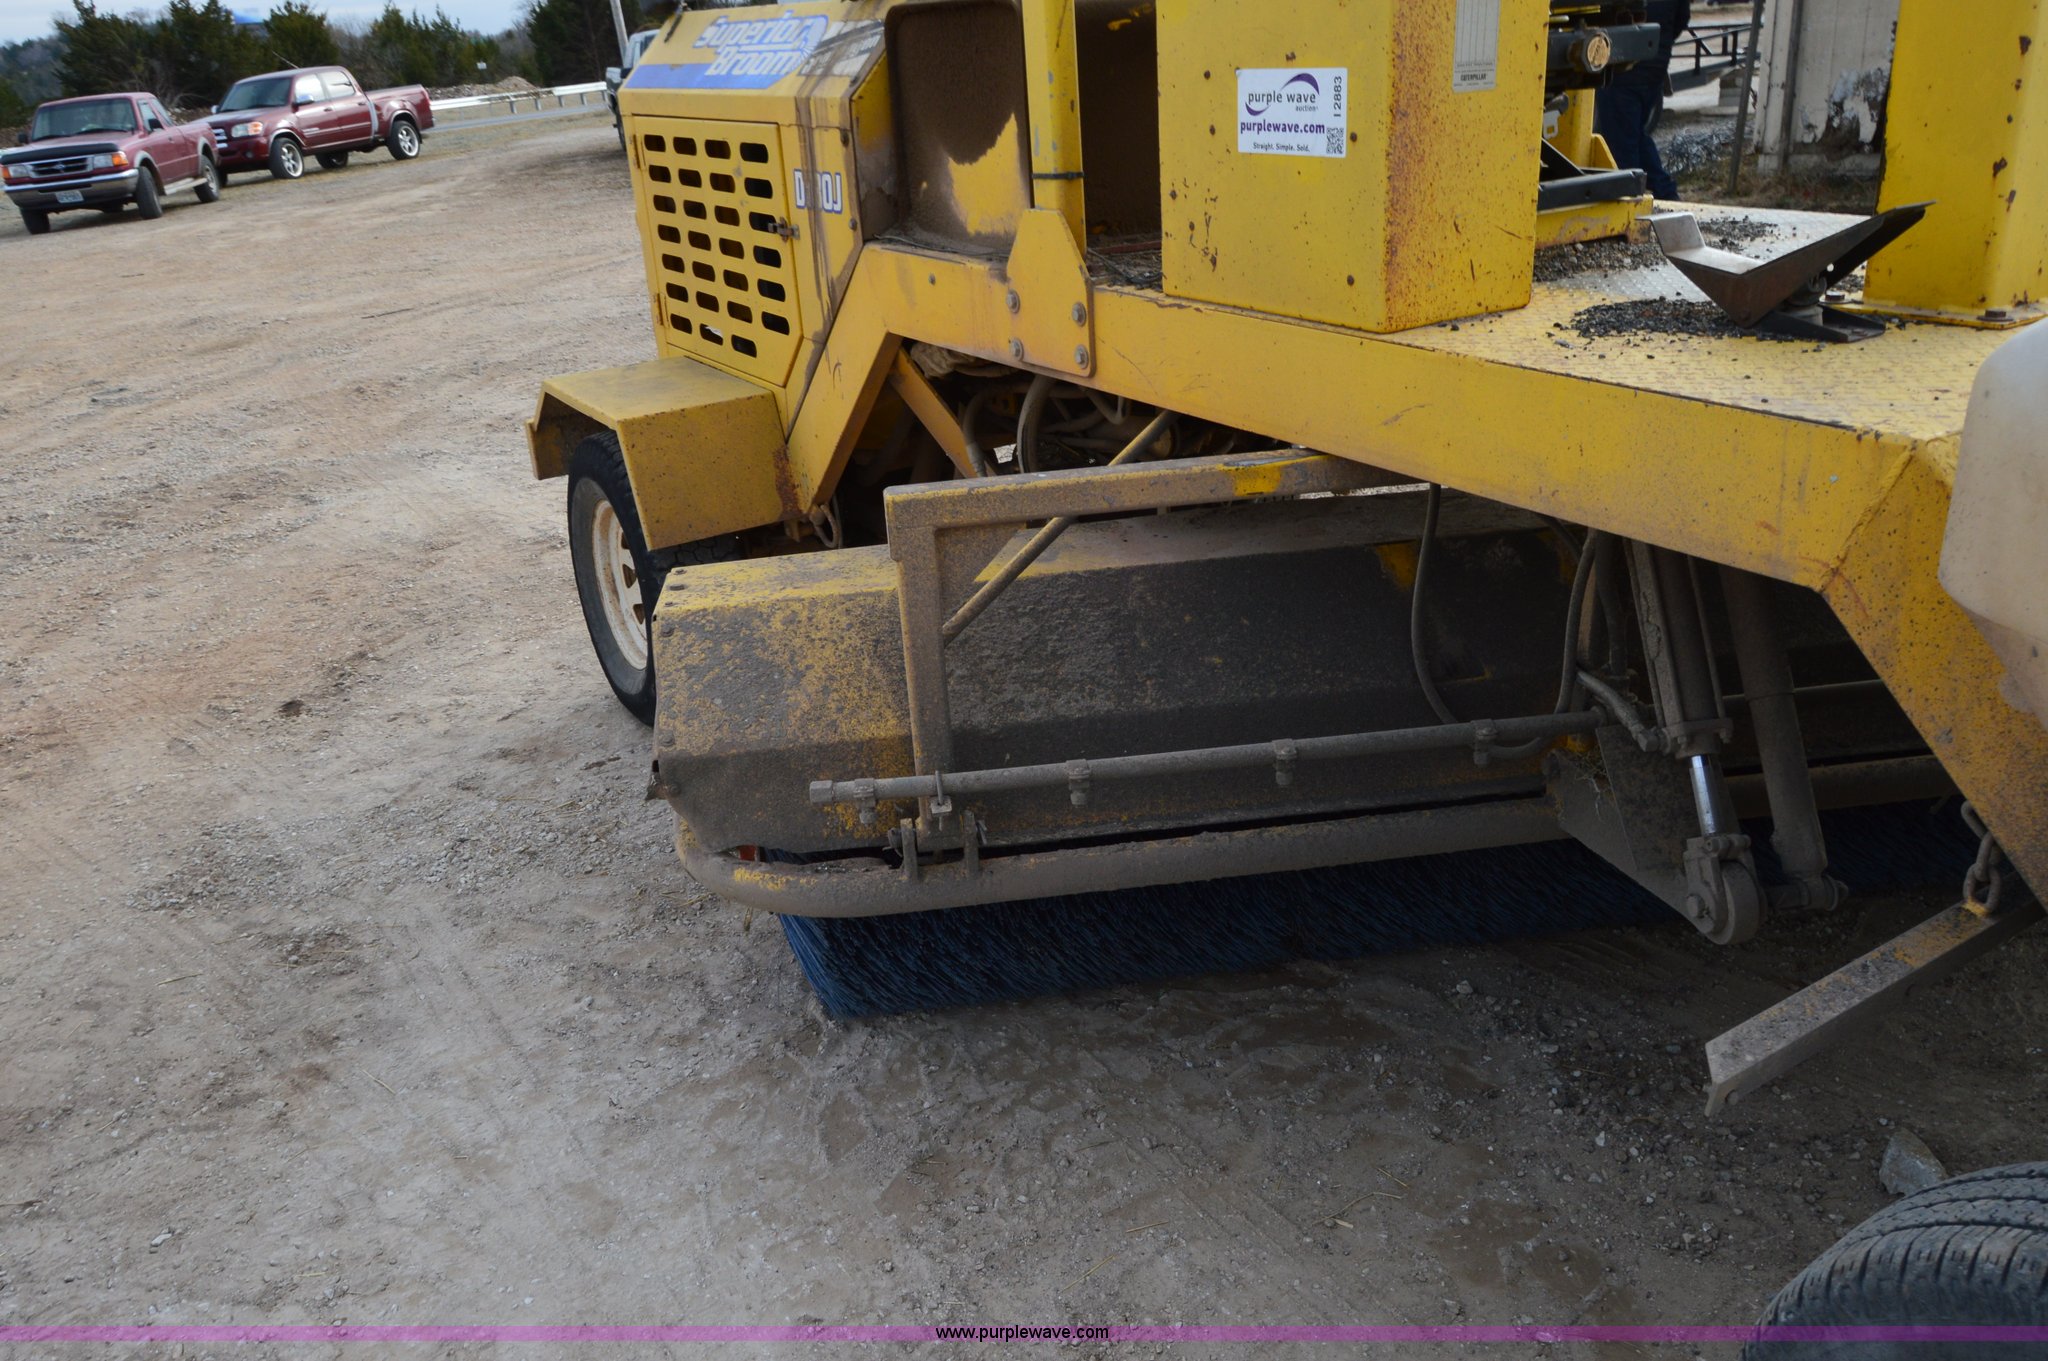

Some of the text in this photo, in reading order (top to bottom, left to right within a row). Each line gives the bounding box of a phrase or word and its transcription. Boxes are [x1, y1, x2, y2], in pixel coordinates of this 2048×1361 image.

[694, 11, 818, 51] Superior
[704, 45, 803, 76] Broom
[1248, 90, 1316, 105] purple wave
[1333, 76, 1343, 117] 12883
[1240, 119, 1325, 135] purplewave.com
